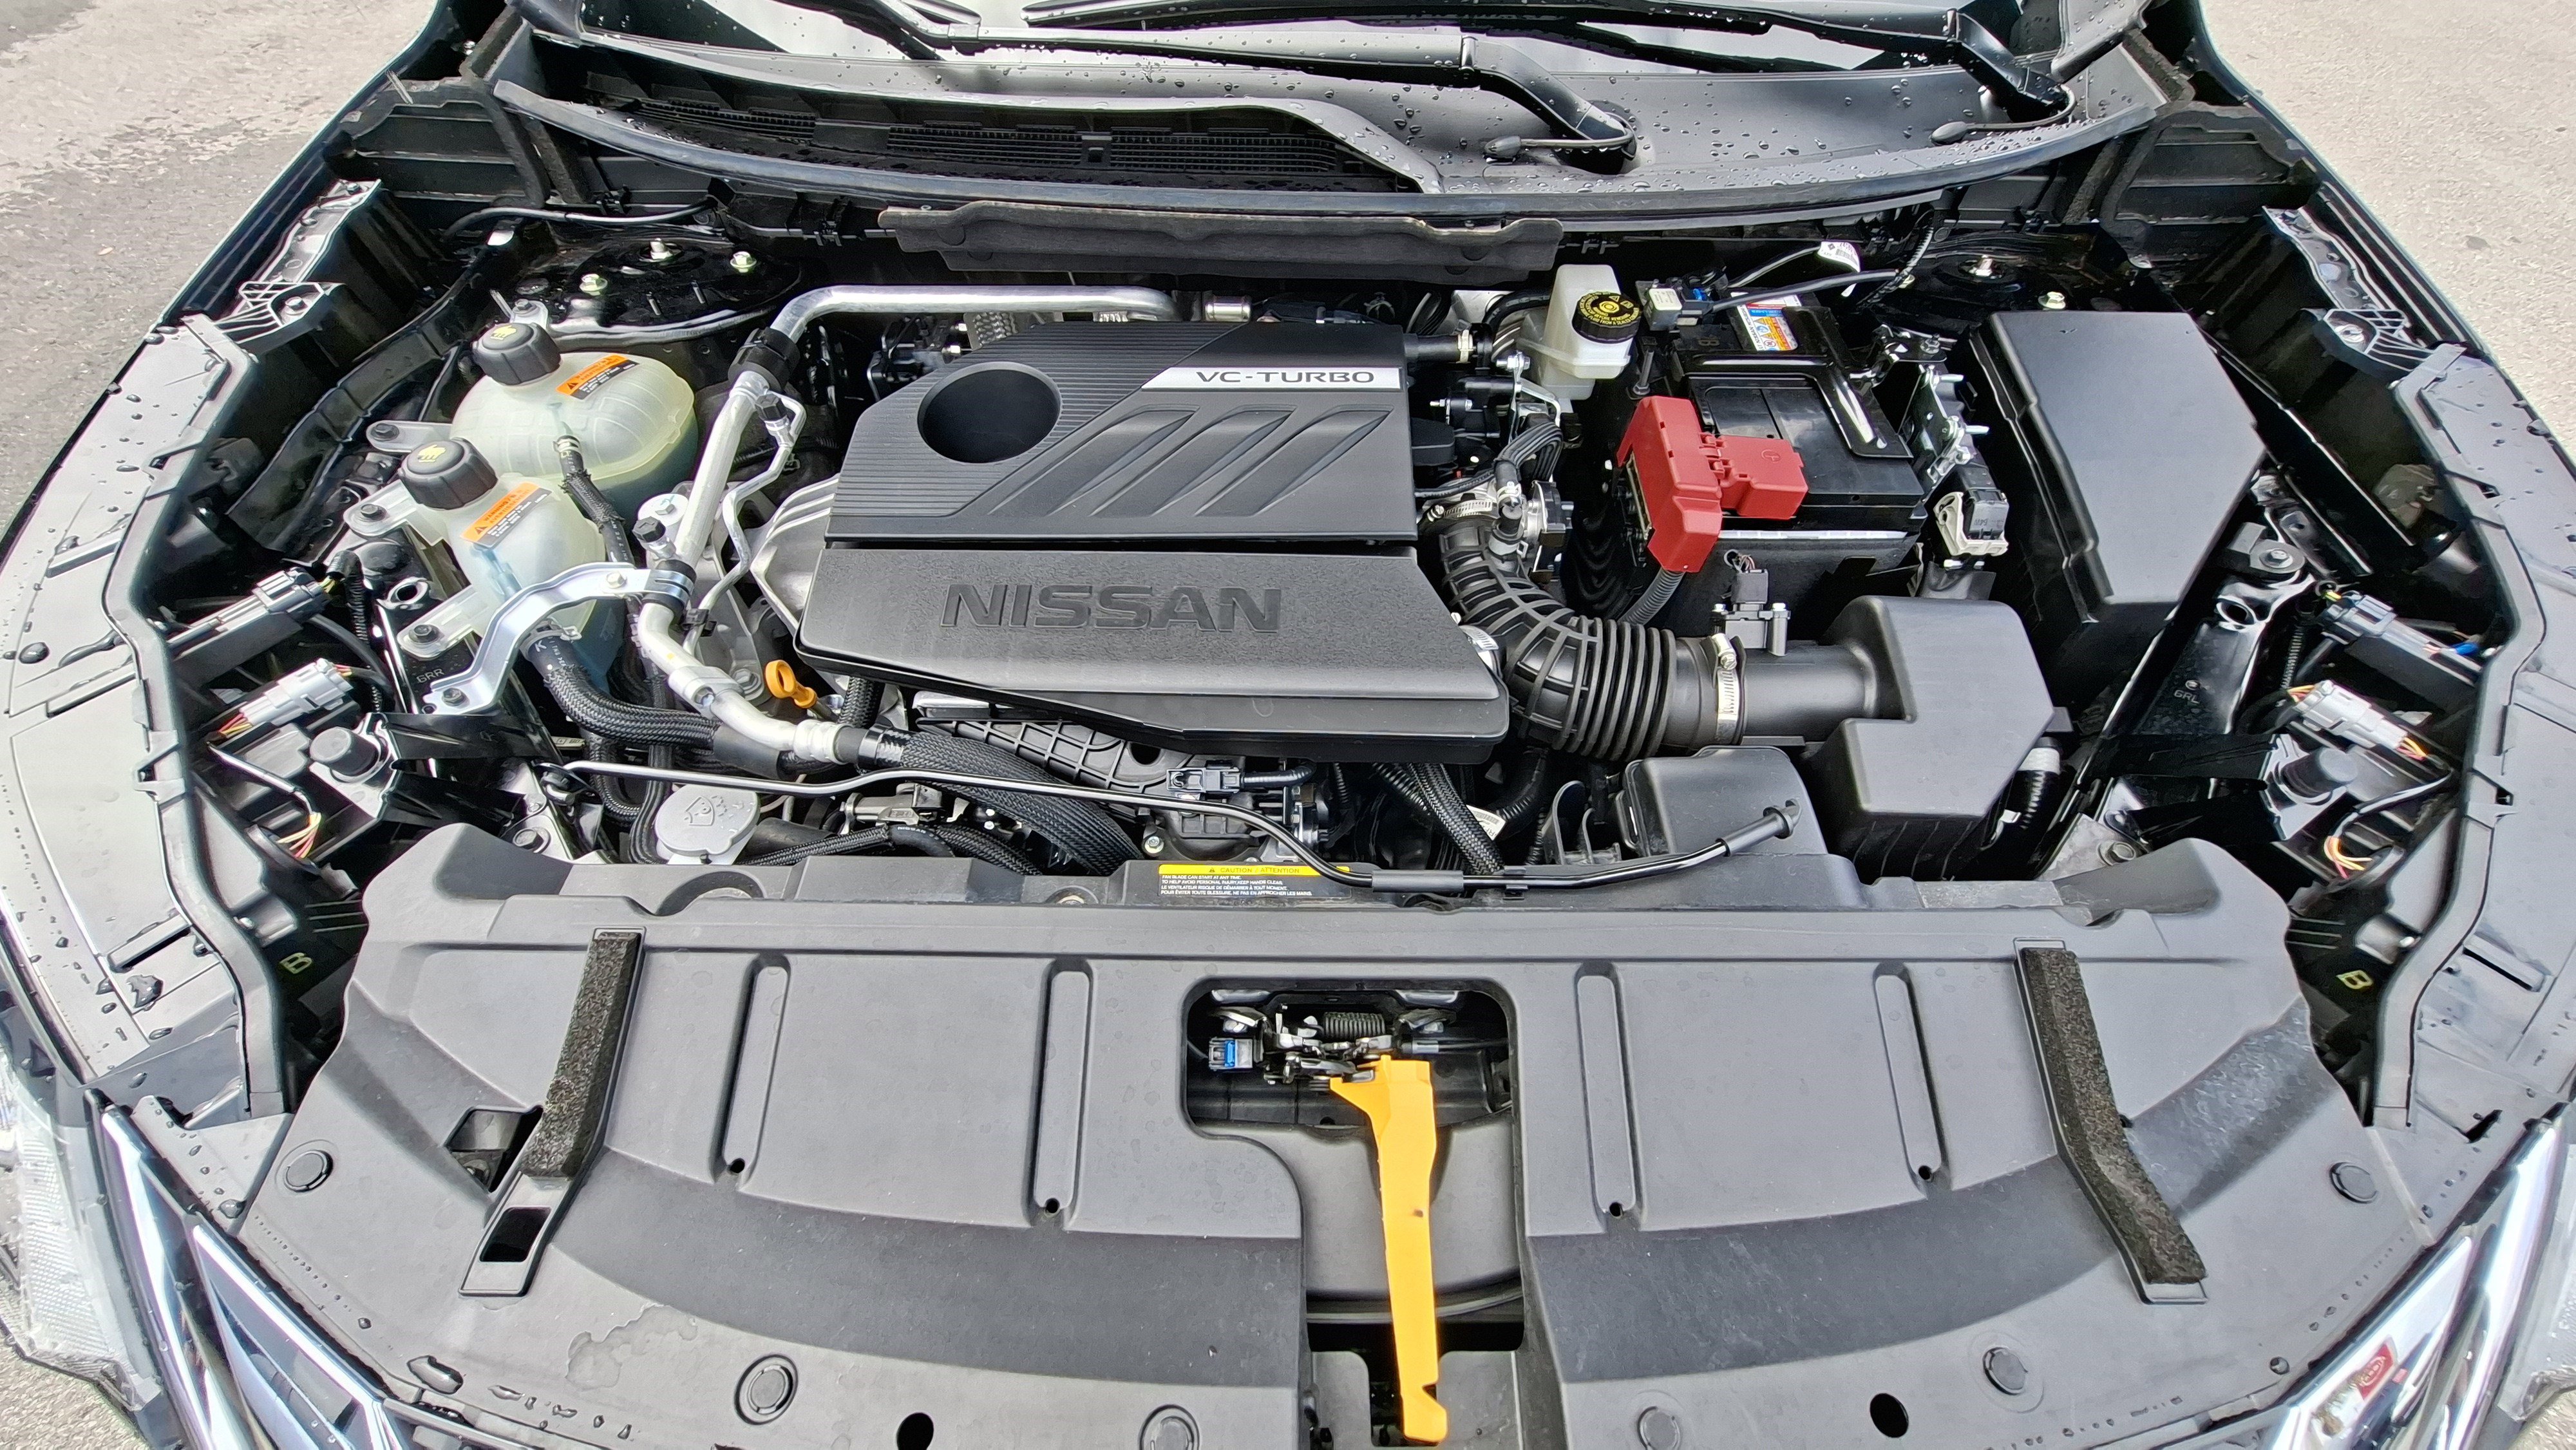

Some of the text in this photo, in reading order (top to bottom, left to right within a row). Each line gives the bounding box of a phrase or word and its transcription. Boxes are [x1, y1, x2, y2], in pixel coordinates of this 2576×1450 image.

[1196, 371, 1374, 383] VC-TURBO
[940, 584, 1281, 633] NISSAN
[279, 952, 312, 974] B
